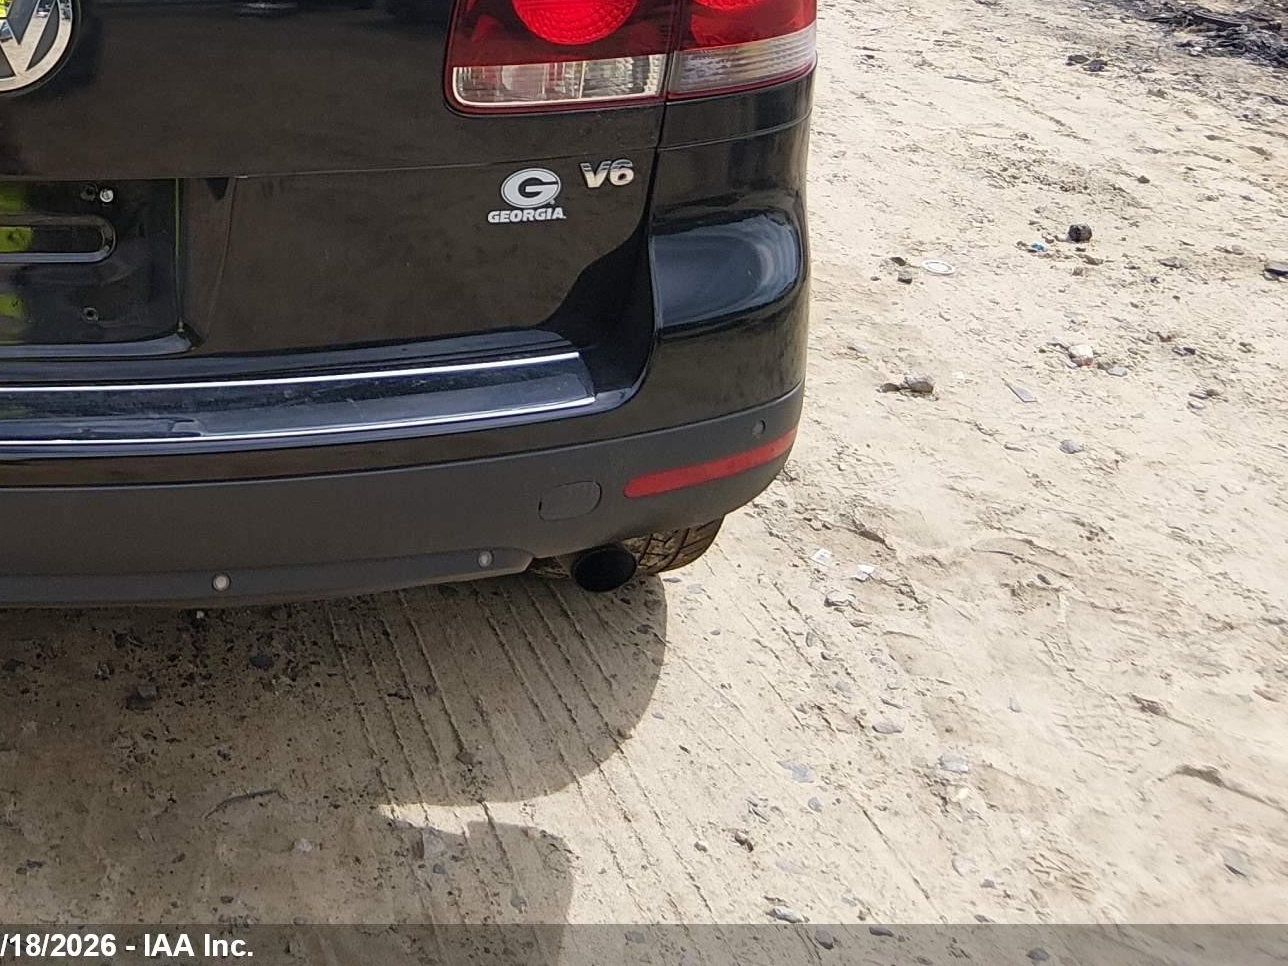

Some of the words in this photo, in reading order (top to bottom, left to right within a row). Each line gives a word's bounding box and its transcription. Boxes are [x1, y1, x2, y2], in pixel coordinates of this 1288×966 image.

[500, 167, 562, 209] G
[580, 158, 635, 189] V6
[487, 207, 566, 223] GEORGIA
